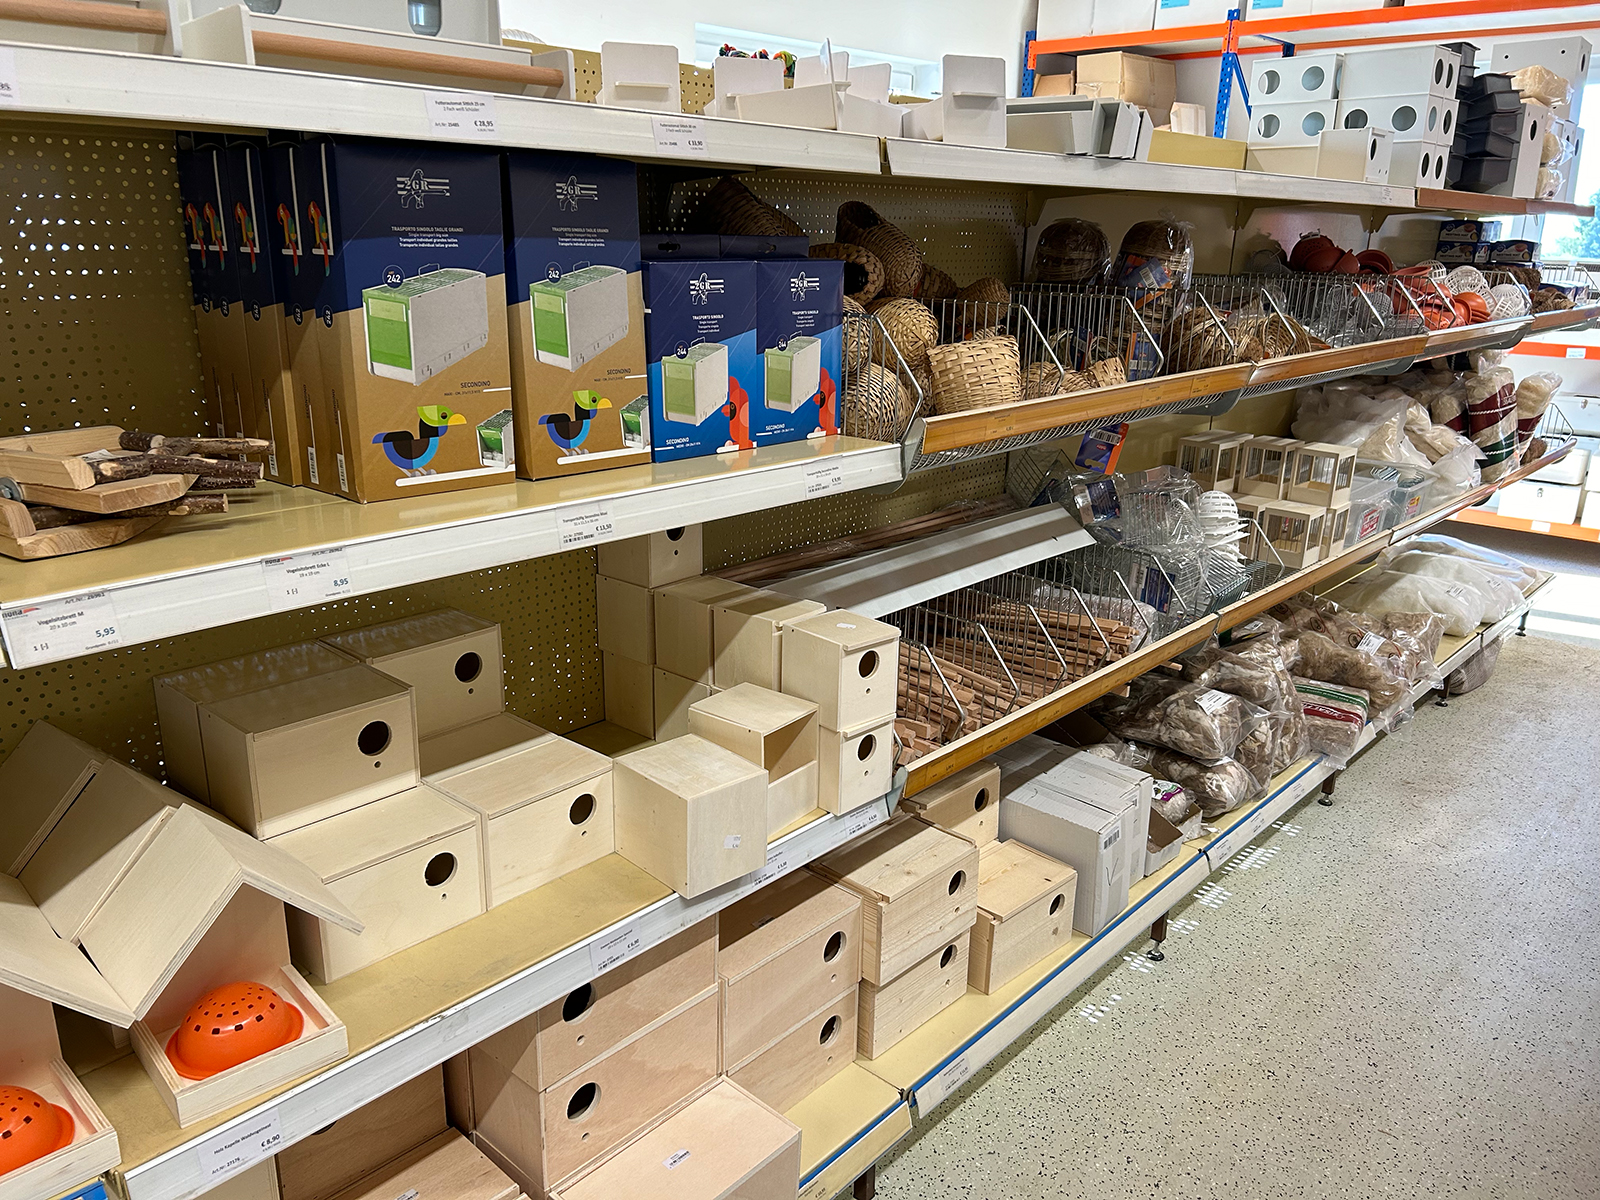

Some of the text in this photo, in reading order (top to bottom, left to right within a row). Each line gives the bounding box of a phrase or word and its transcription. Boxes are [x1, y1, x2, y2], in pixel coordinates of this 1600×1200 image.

[404, 180, 428, 190] 2GR
[562, 186, 581, 194] 2GR
[387, 275, 400, 283] 242
[677, 347, 687, 355] 244
[286, 565, 316, 574] Vogelsitzbrett
[334, 578, 349, 586] 8,95
[37, 613, 76, 626] Vogelsitzbrett
[96, 627, 116, 638] 5,95
[266, 1134, 280, 1145] 8,90
[224, 1140, 240, 1149] Kapelle
